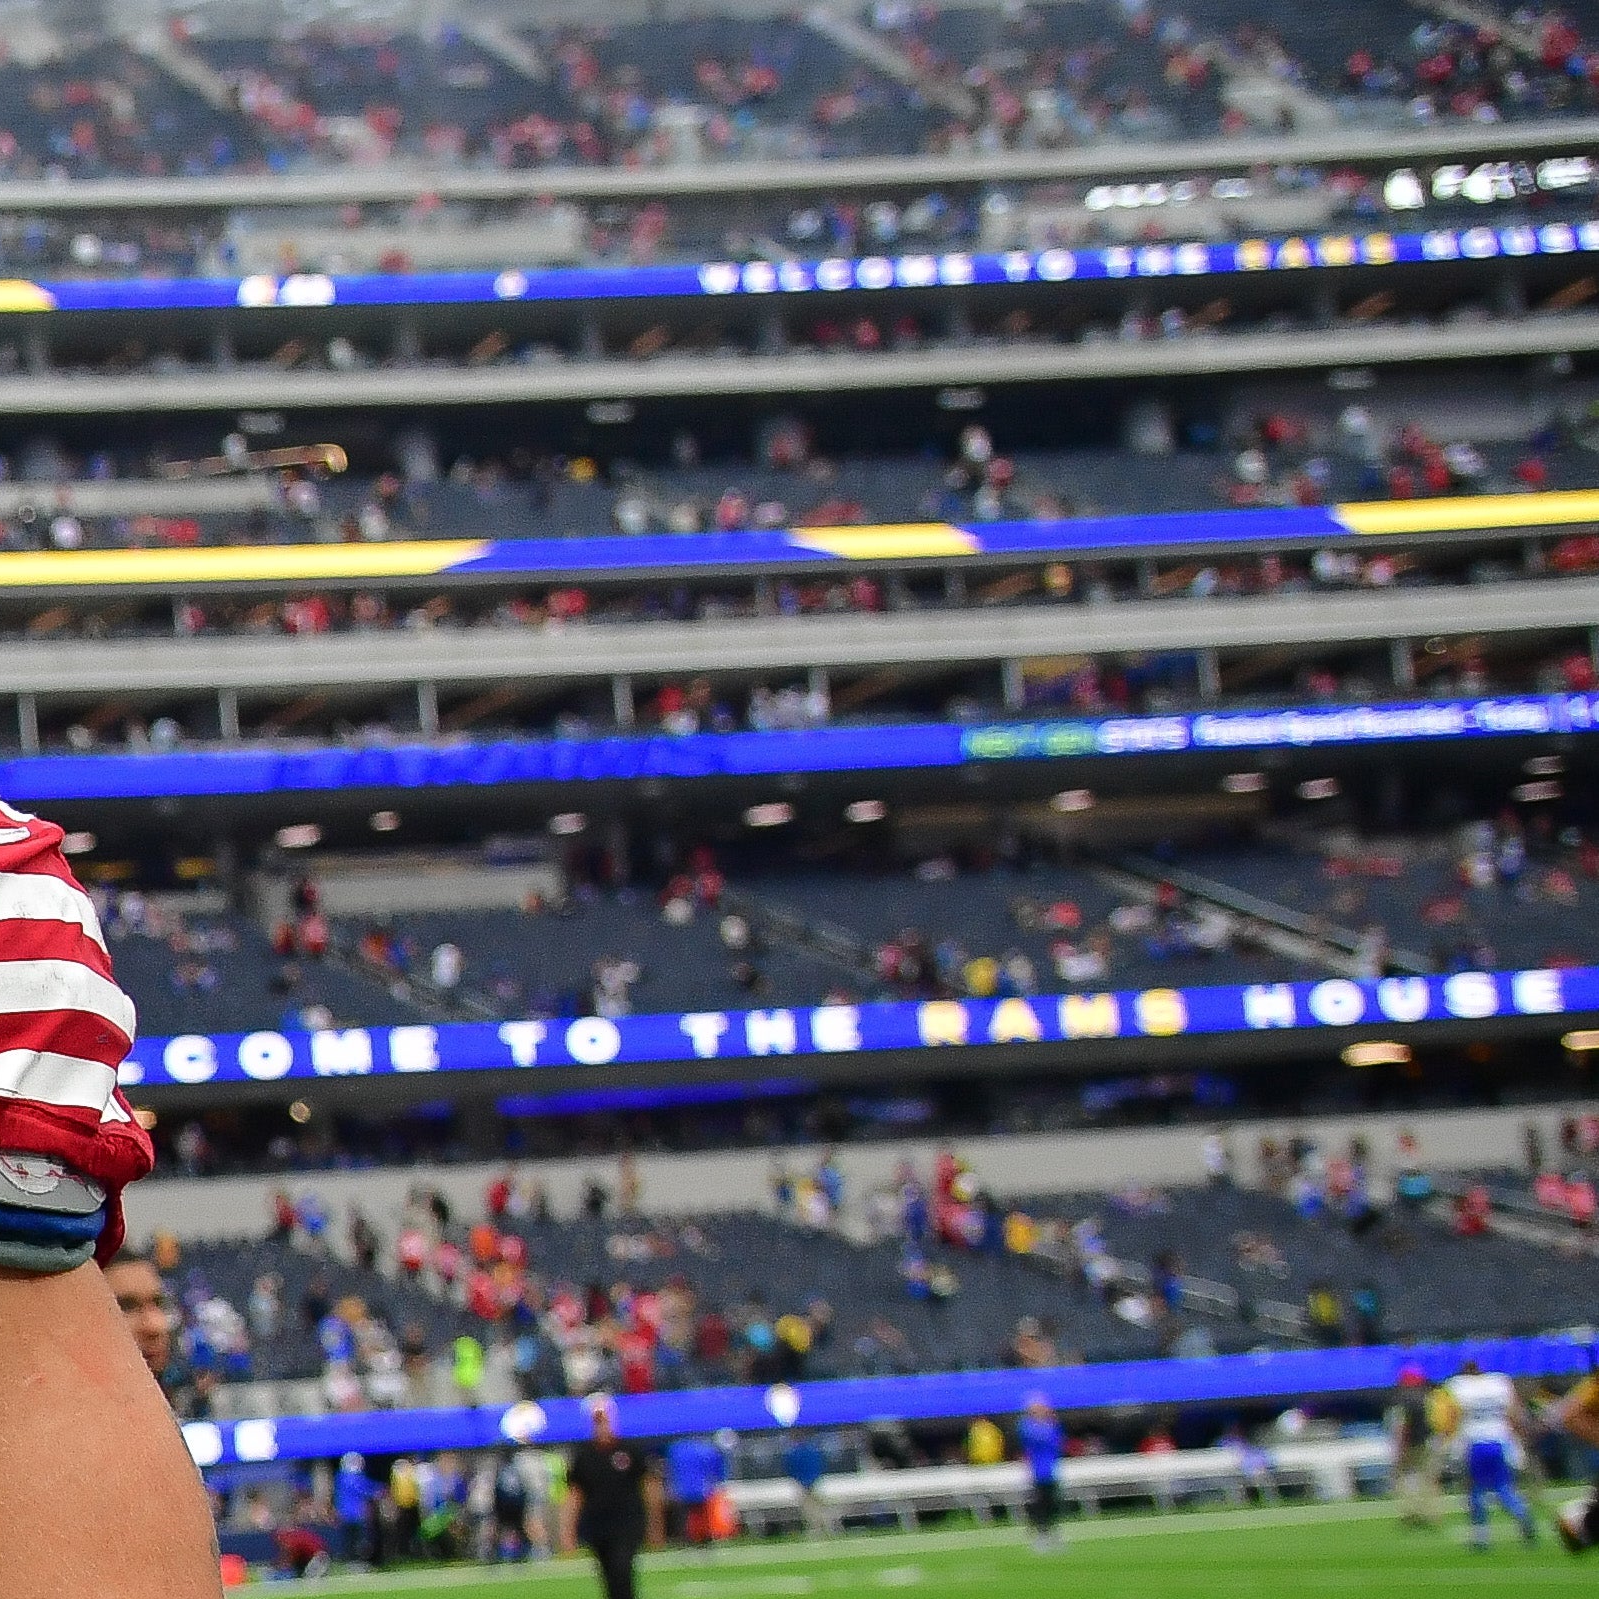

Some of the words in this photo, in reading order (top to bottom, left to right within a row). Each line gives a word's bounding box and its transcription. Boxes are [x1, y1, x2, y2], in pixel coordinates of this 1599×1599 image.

[498, 1016, 622, 1068] TO
[678, 1003, 862, 1059] THE
[916, 986, 1188, 1048] RAMS
[1242, 969, 1565, 1029] HOUSE
